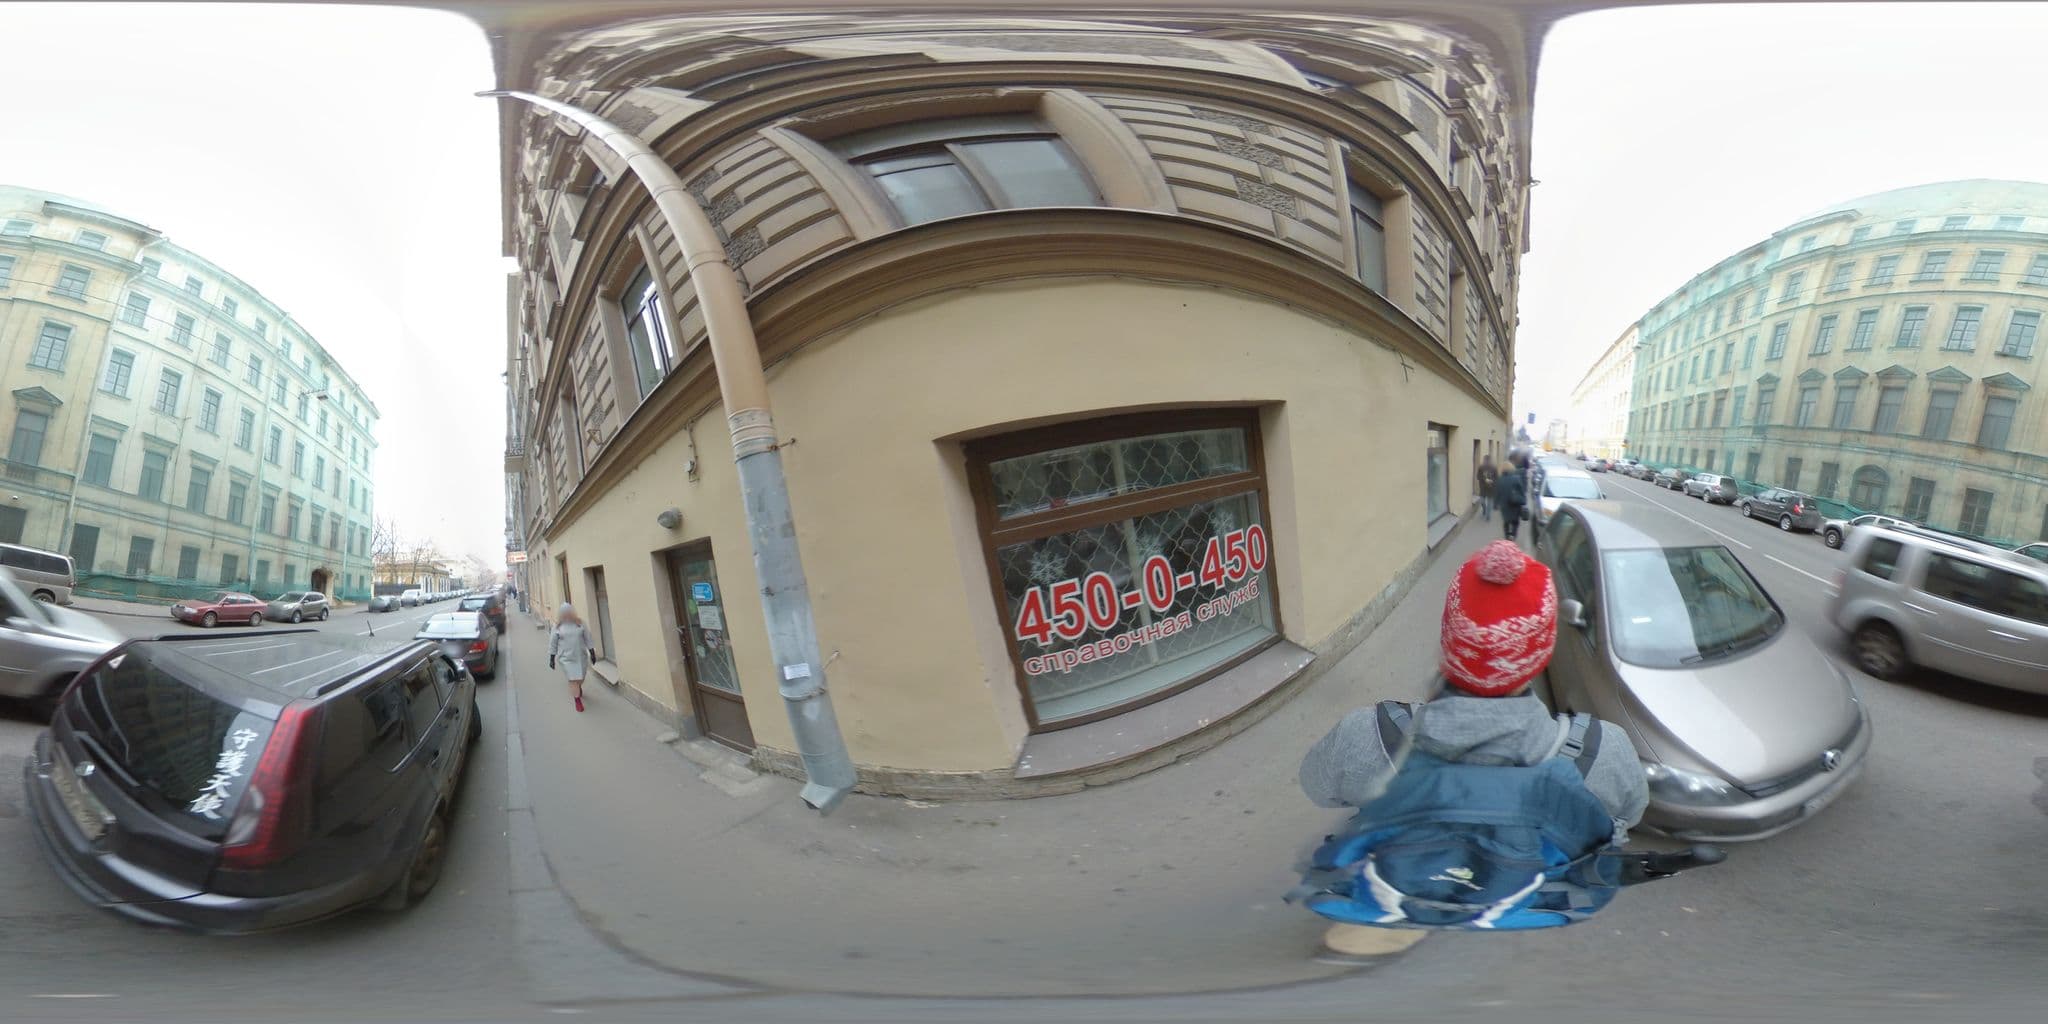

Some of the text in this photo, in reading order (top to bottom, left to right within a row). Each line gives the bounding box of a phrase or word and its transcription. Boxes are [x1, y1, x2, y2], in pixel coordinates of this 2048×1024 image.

[1015, 523, 1267, 646] 450-0-450
[1024, 575, 1260, 675] справочная служб
